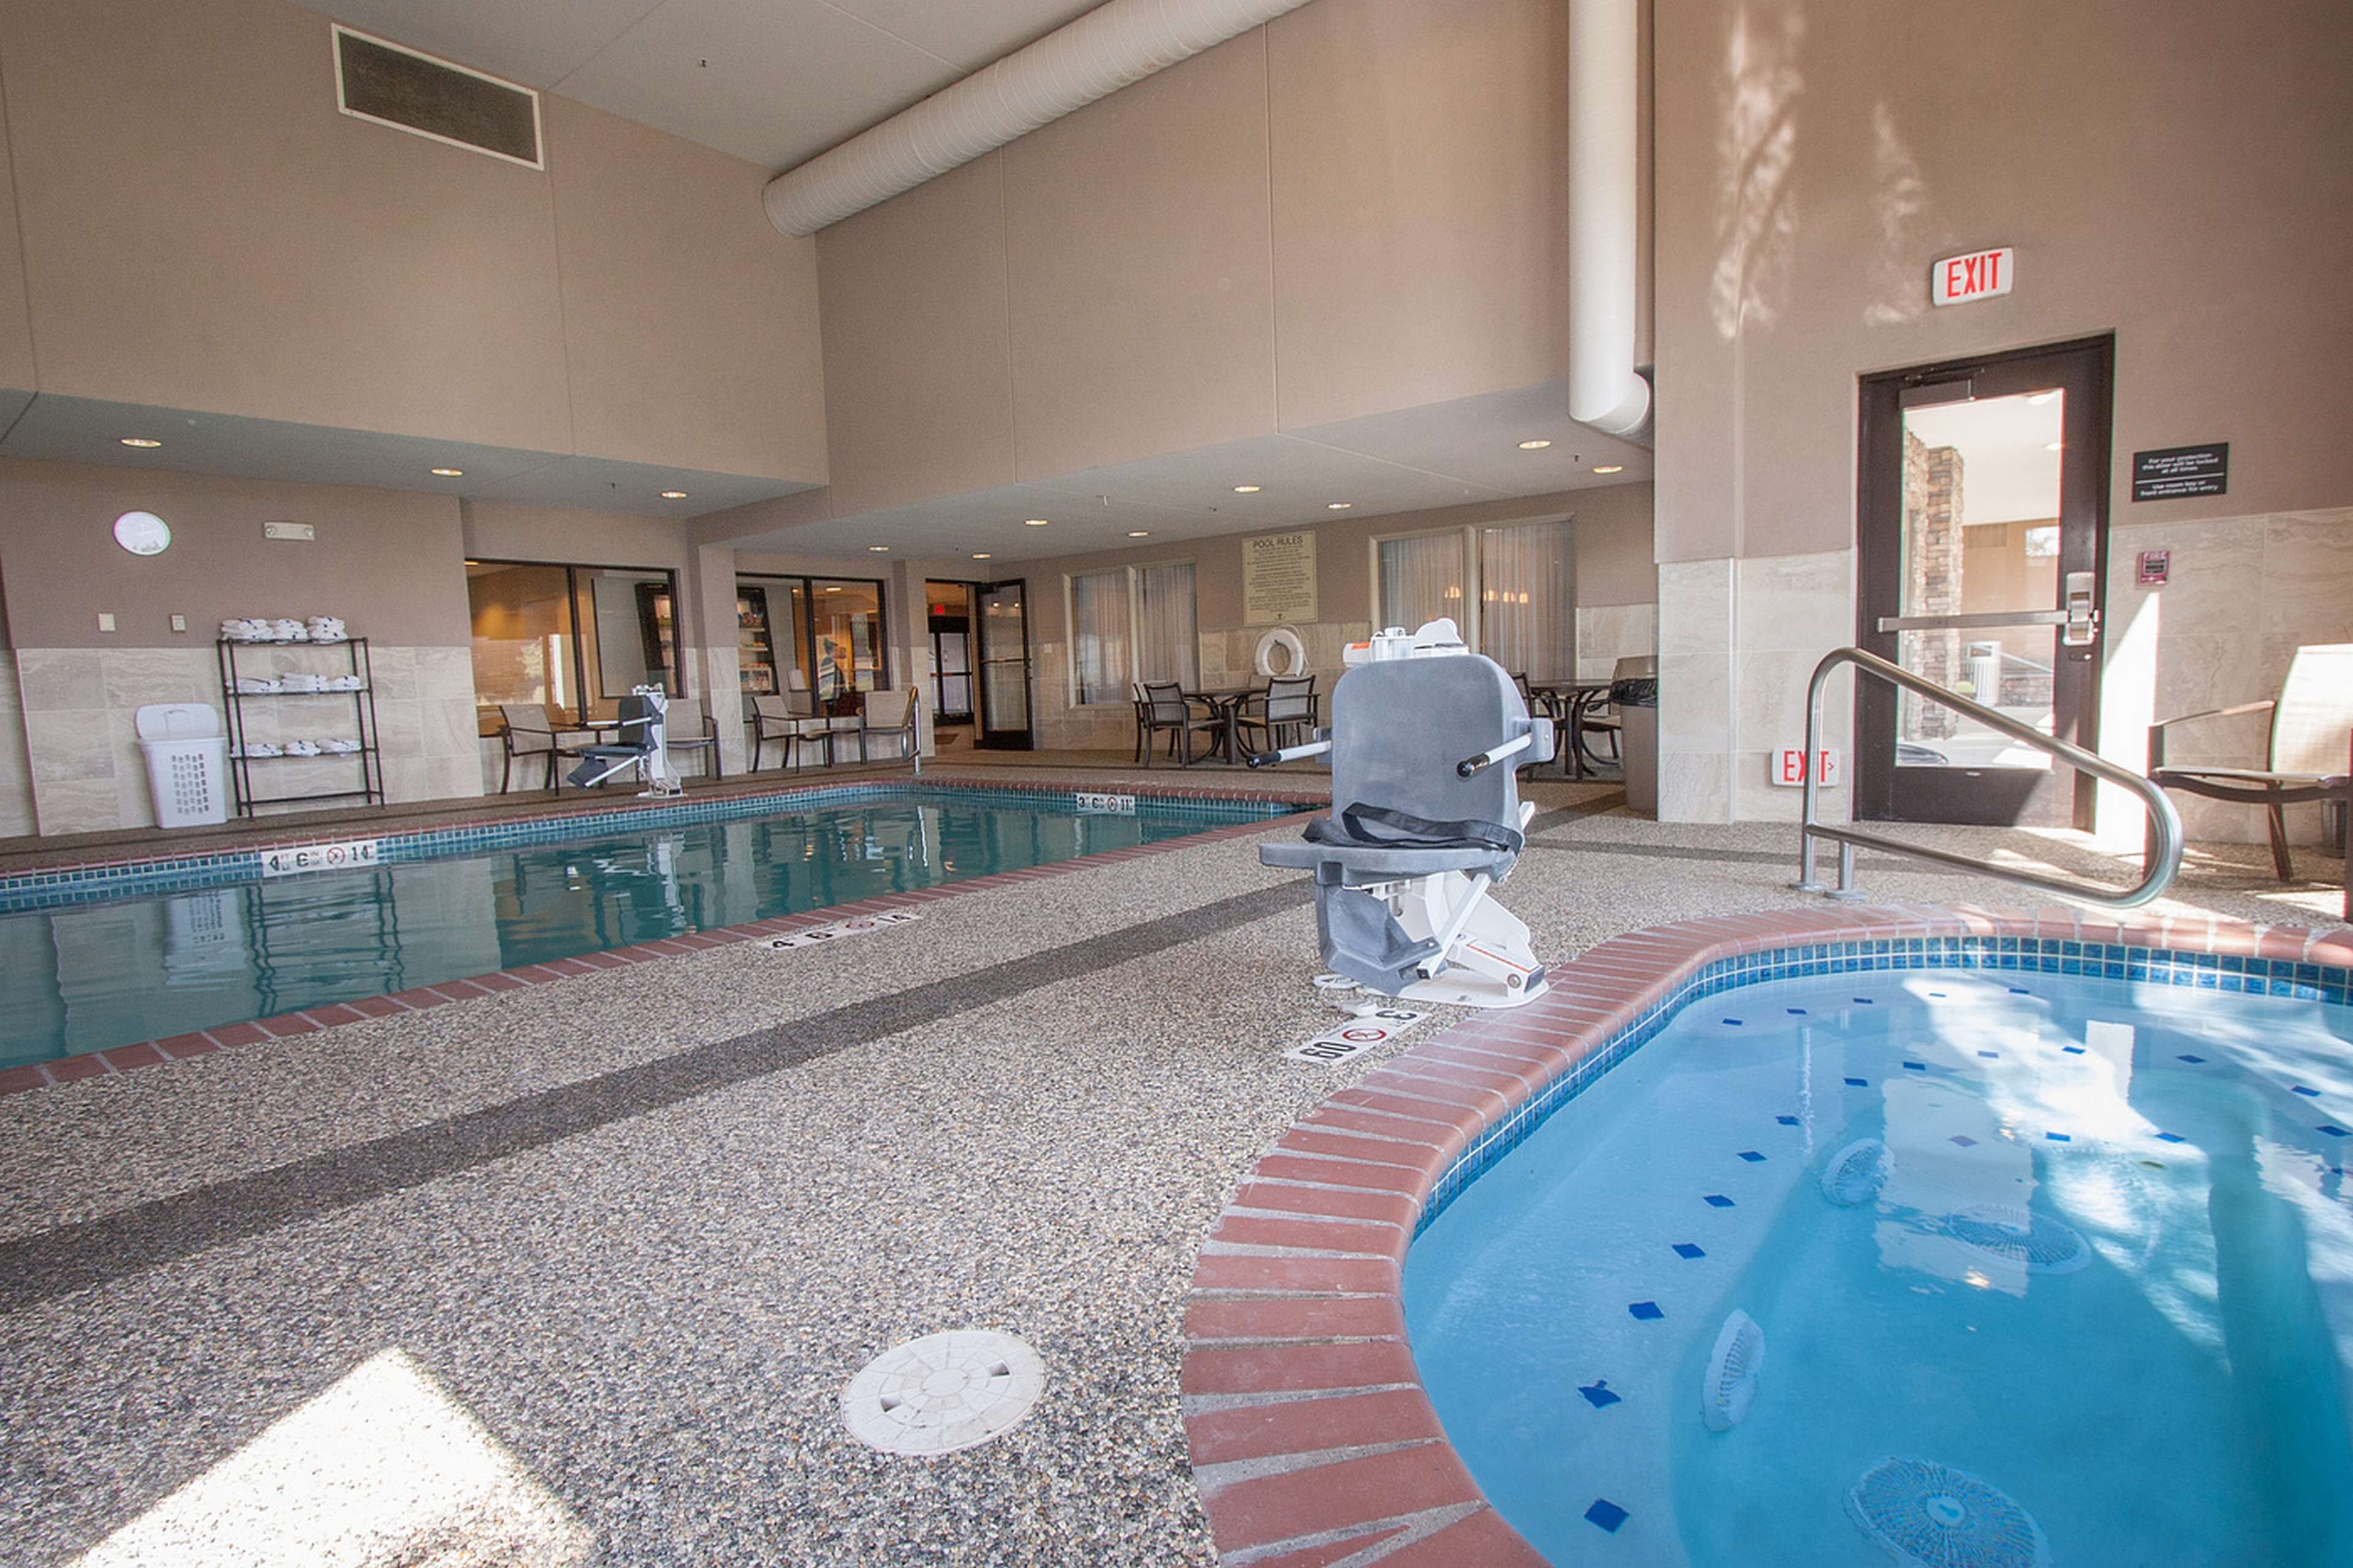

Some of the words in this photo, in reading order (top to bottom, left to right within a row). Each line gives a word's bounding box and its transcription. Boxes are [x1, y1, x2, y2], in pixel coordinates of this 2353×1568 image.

[1947, 253, 2002, 297] EXIT
[2177, 453, 2213, 462] protection
[1253, 539, 1274, 549] POOL
[1277, 535, 1303, 546] RULES
[1783, 750, 1830, 782] EXT
